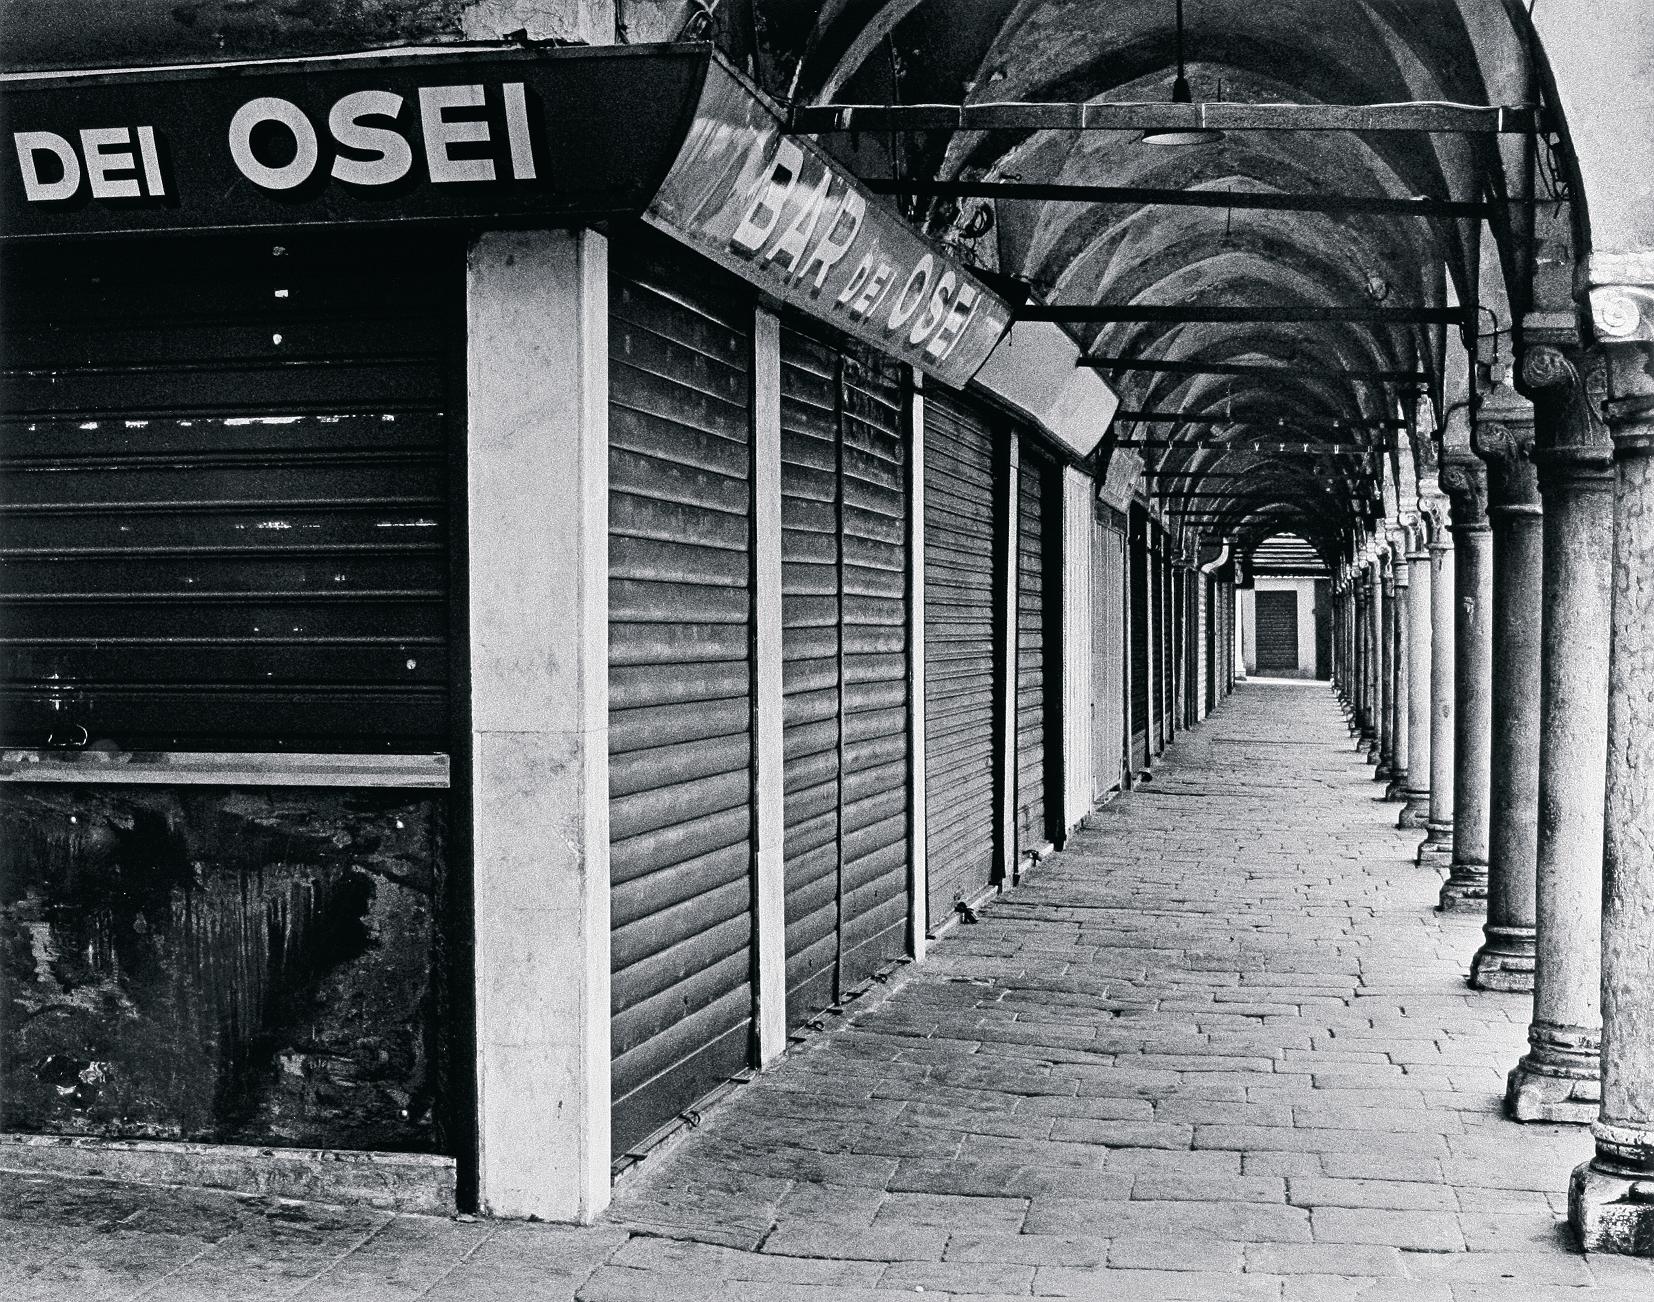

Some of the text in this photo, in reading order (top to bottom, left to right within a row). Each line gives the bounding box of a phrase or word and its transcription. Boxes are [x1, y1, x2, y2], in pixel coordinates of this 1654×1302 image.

[14, 82, 537, 202] DEI OSEI
[732, 135, 982, 361] BAR DEI OSEI
